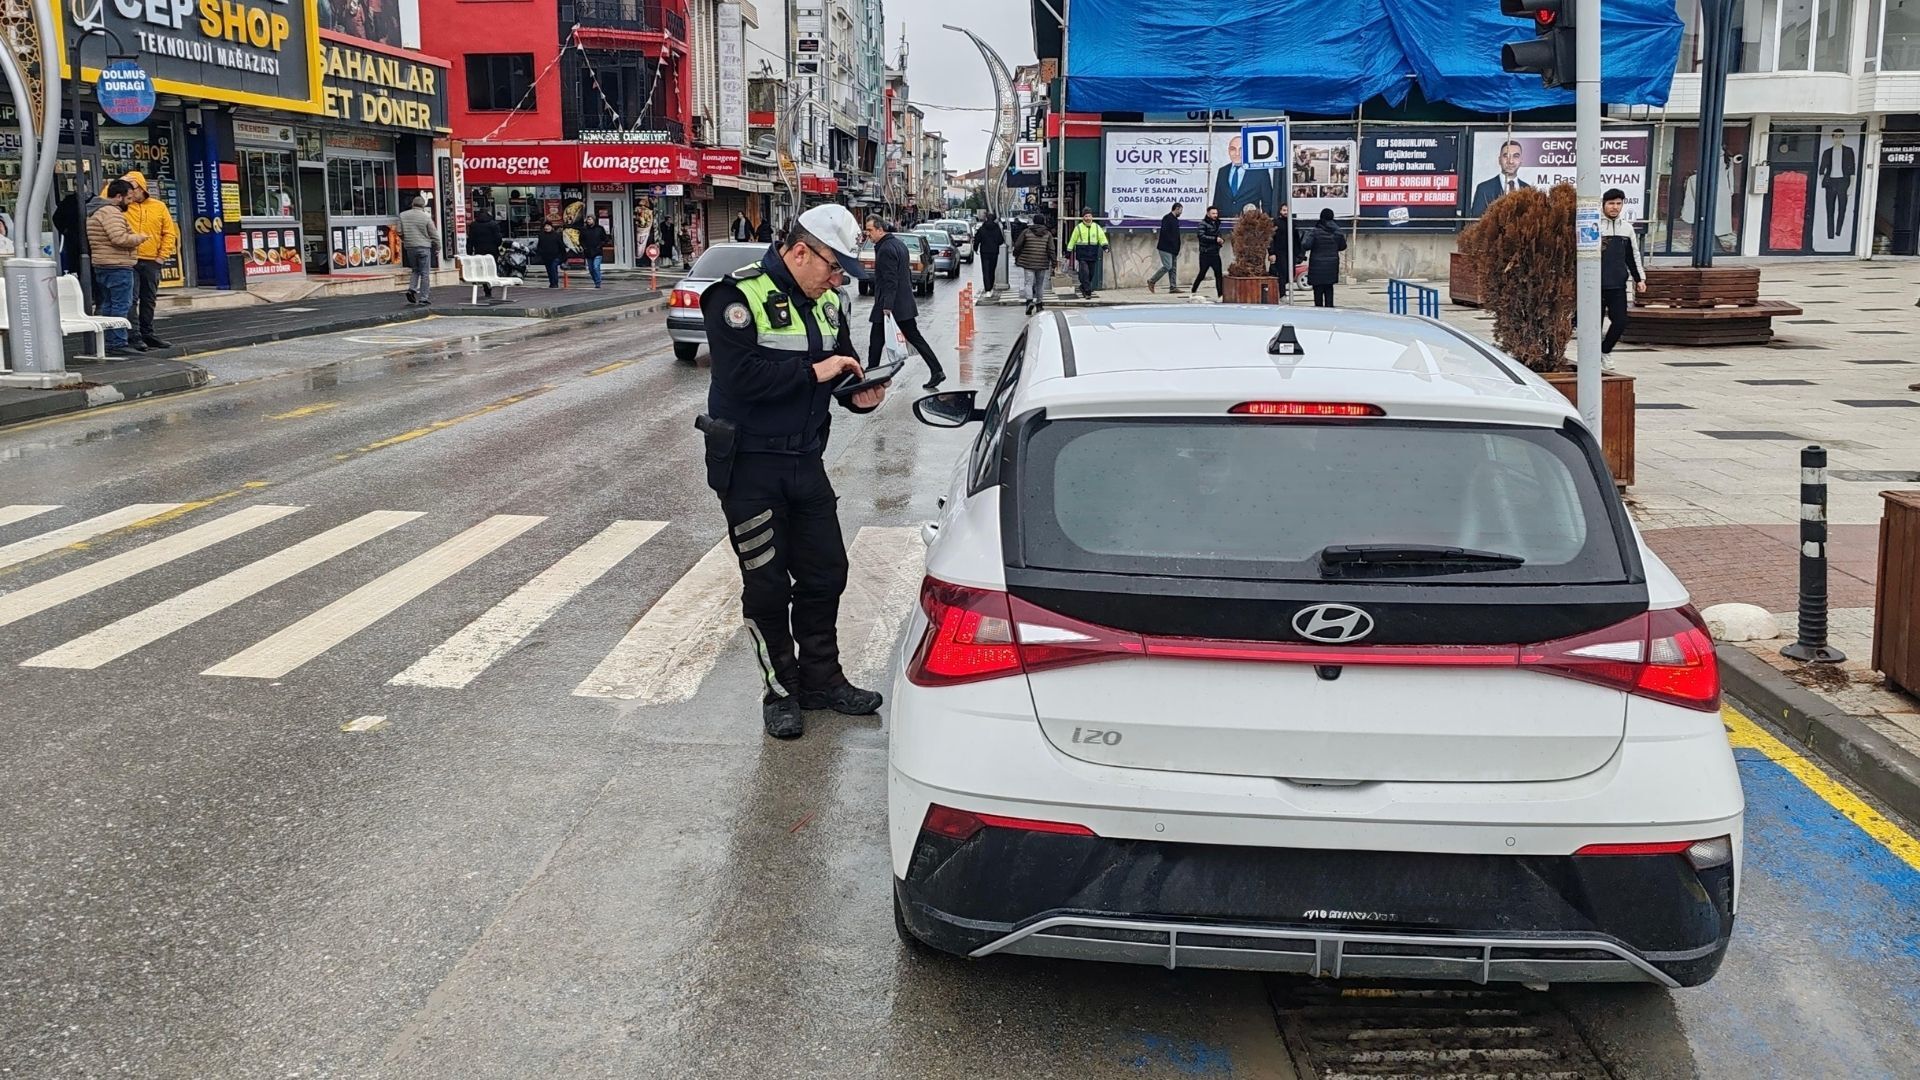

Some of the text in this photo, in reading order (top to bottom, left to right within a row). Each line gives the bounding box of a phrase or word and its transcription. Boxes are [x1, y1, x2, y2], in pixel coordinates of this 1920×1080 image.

[138, 31, 280, 76] TEKNOLOJİ MAĞAZASI
[105, 81, 145, 90] DURAĞI
[323, 86, 431, 130] ET DÖNER
[1253, 135, 1274, 160] D
[1376, 139, 1388, 147] BEN
[1542, 140, 1573, 151] GENÇ
[463, 152, 549, 174] komagene
[583, 151, 670, 174] komagene
[1024, 150, 1034, 163] E
[1116, 147, 1209, 167] UĞUR YEŞİL
[1539, 152, 1638, 165] GÜÇLÜ ECEK...
[1887, 153, 1915, 164] GİRİŞ
[1376, 162, 1436, 171] sevgiyle bakarım.
[1365, 175, 1449, 190] YENİ BİR SORGUN İÇİN
[1537, 174, 1550, 184] M.
[194, 160, 208, 214] TURKCELL
[210, 160, 220, 214] TURKCELL
[1144, 196, 1177, 204] BAŞKAN
[1361, 192, 1374, 201] HEP
[1409, 192, 1422, 201] HEP
[1424, 192, 1455, 202] BERABER
